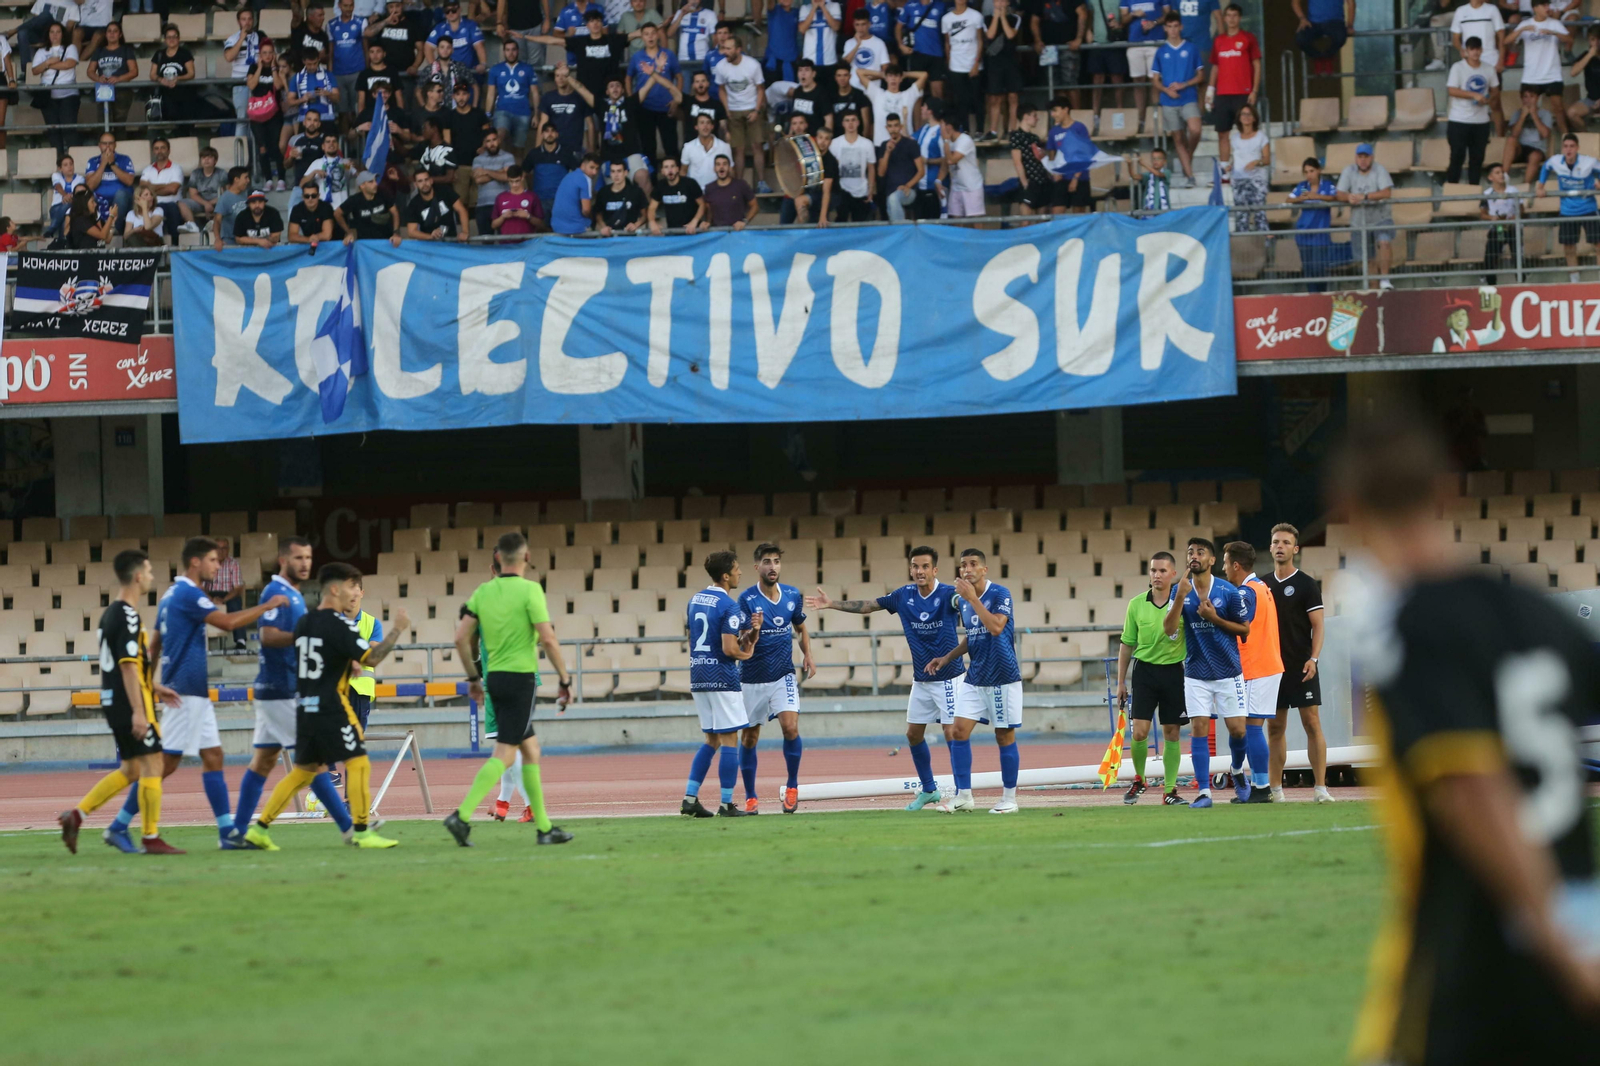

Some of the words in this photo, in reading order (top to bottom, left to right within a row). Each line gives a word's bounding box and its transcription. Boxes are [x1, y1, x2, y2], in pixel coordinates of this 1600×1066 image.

[22, 256, 79, 271] KOMANDO
[972, 231, 1216, 381] SUR
[1510, 290, 1600, 339] Cruz
[82, 319, 129, 336] XEREZ
[1256, 325, 1303, 350] Xerez
[1305, 316, 1327, 337] CD
[69, 353, 88, 389] SIN
[116, 357, 137, 370] con
[126, 367, 173, 391] Xerez
[693, 612, 711, 651] 2
[295, 636, 324, 680] 15
[1493, 643, 1583, 845] 5
